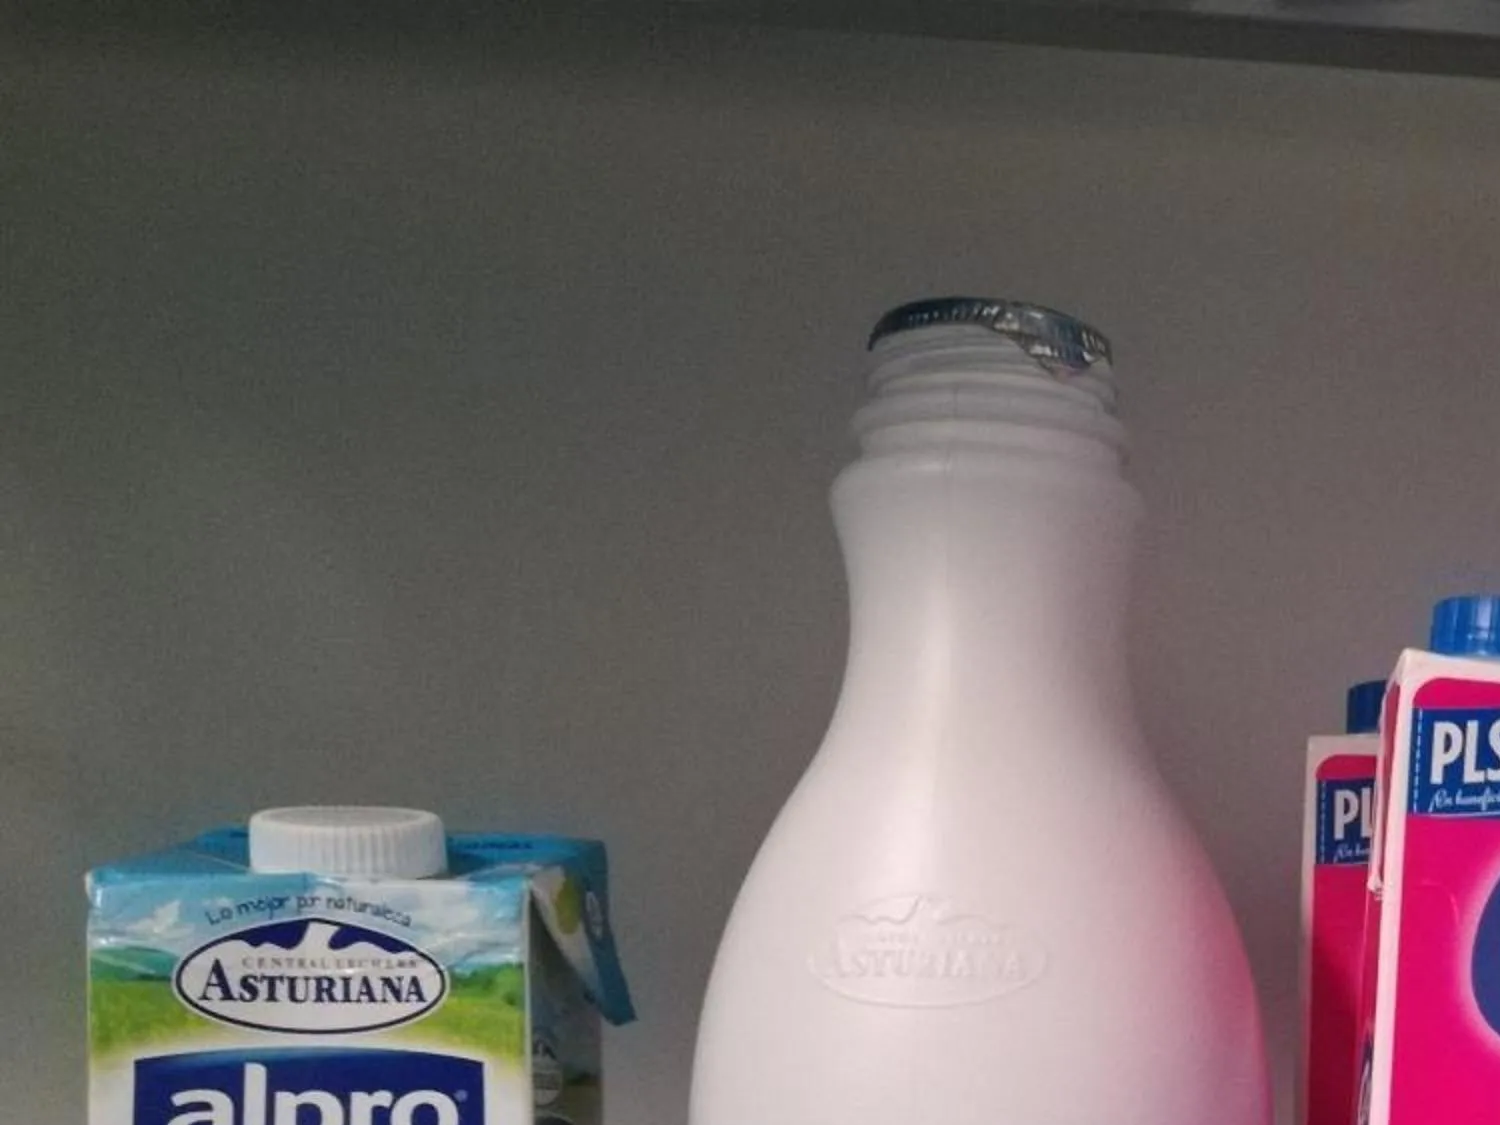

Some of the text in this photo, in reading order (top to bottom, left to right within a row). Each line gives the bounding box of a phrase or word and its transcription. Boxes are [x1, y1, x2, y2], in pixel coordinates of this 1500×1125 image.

[1333, 787, 1374, 841] PL
[326, 897, 412, 927] naturaleza
[200, 958, 427, 1004] ASTURIANA
